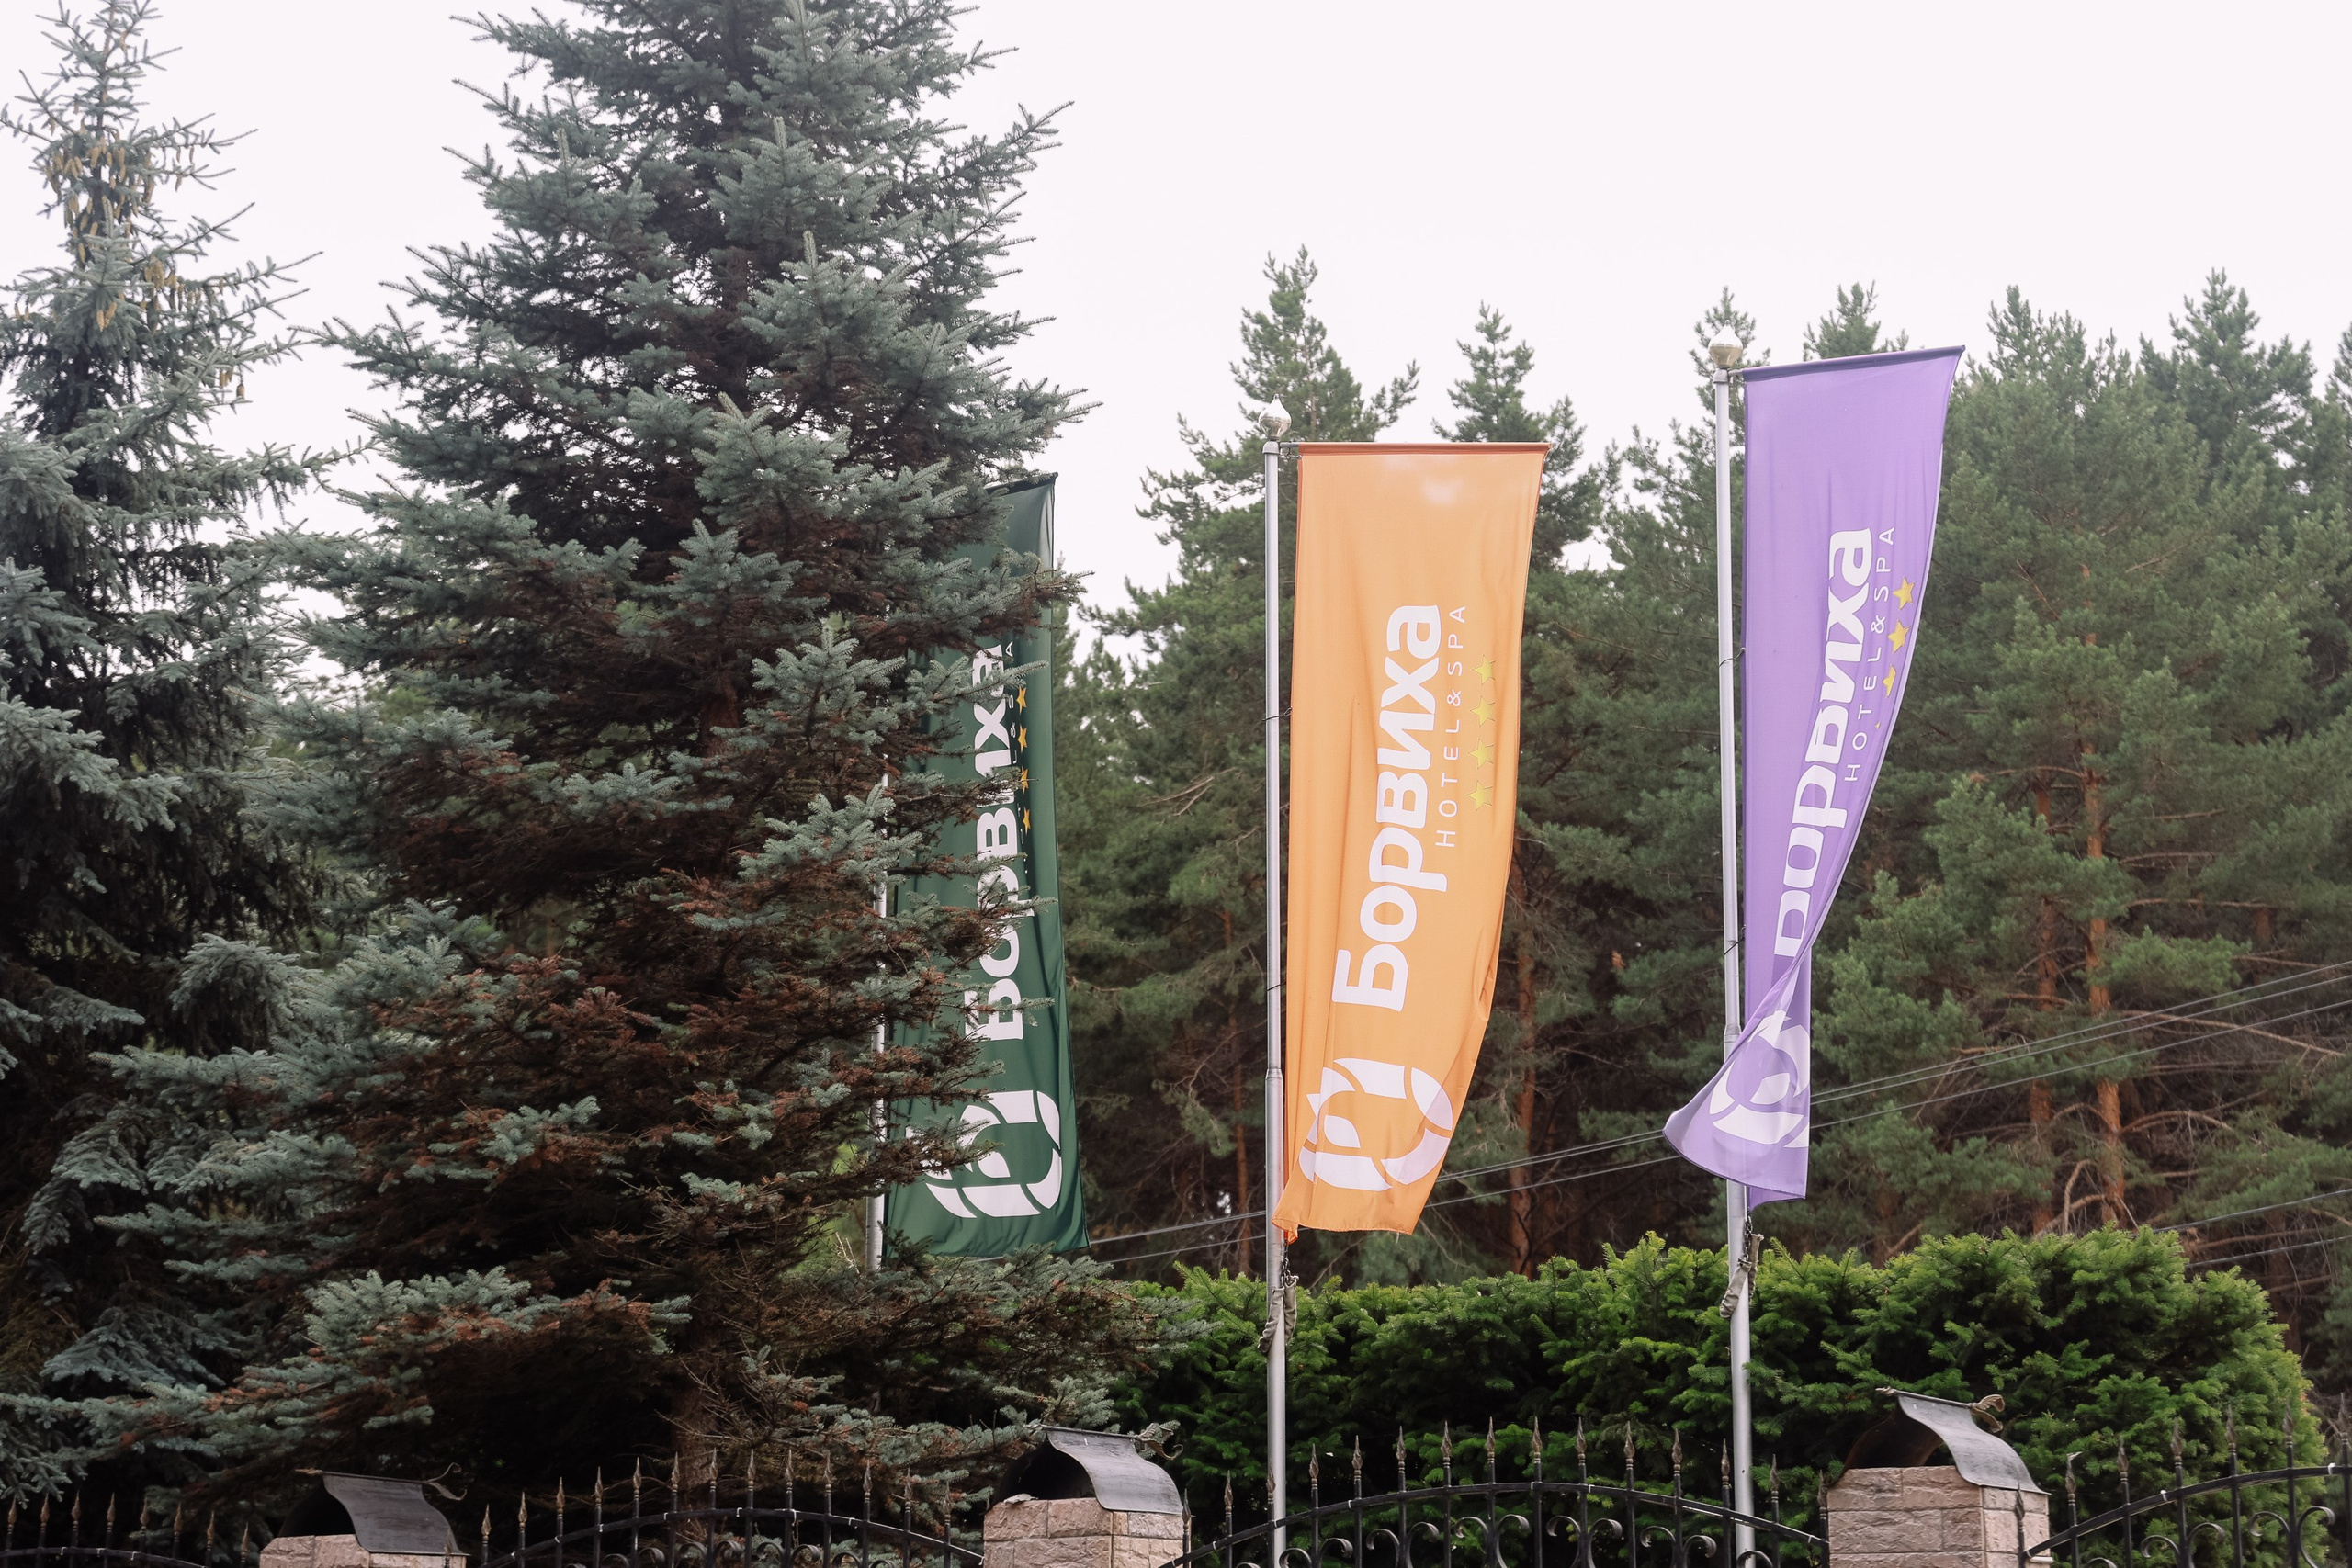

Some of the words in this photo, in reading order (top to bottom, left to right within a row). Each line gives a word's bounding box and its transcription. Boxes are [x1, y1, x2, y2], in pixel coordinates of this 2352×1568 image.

[1873, 526, 1895, 603] SPA
[1447, 605, 1466, 677] SPA
[1871, 615, 1886, 634] &
[1446, 689, 1462, 707] &
[1844, 646, 1882, 782] HOTEL
[1331, 604, 1448, 1012] Борвиха
[1435, 719, 1461, 848] HOTEL
